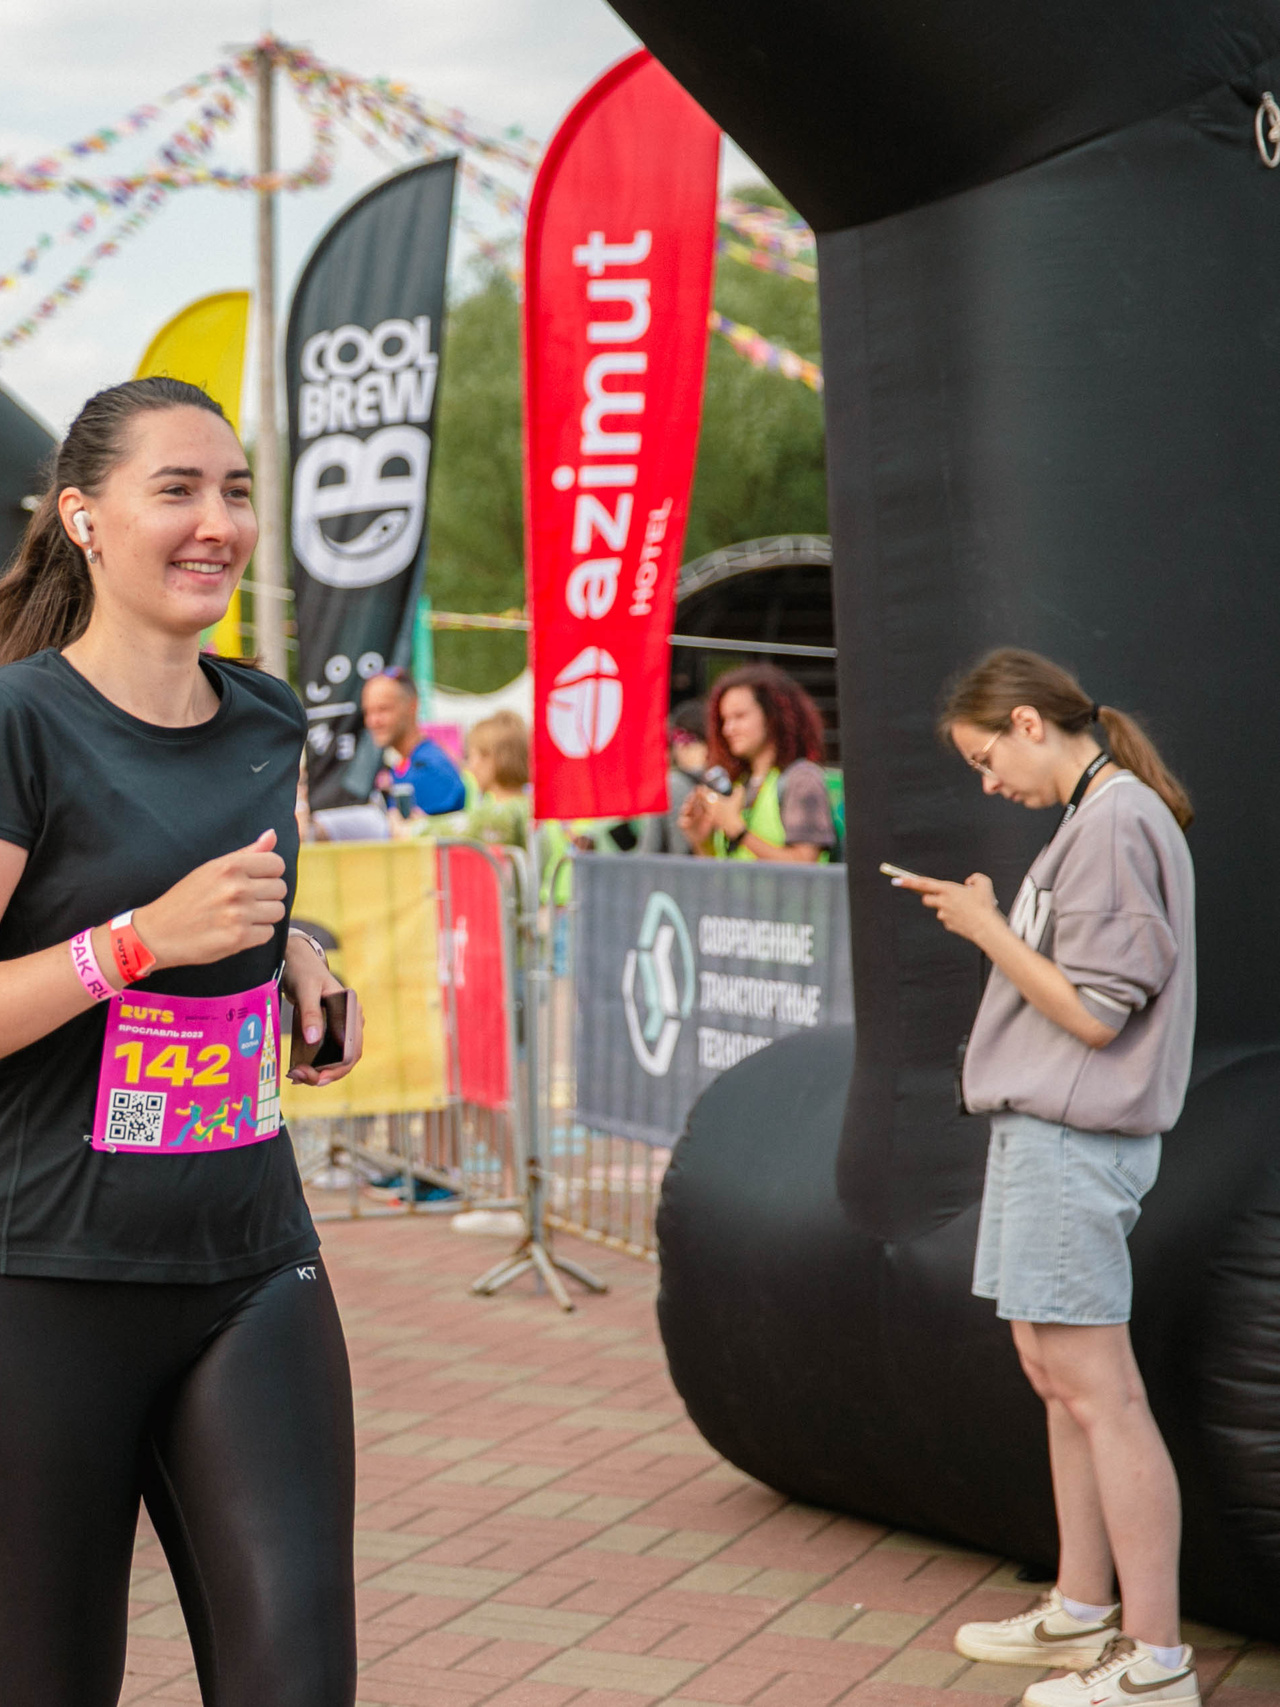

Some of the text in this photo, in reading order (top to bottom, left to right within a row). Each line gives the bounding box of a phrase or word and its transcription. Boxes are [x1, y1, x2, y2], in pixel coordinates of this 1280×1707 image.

[300, 314, 439, 383] COOL
[298, 366, 438, 440] BREW
[551, 229, 652, 620] azimut
[628, 496, 673, 617] HOTEL
[118, 1024, 204, 1039] ЯРОСЛАВЛЬ 2023
[120, 1004, 175, 1024] RUTS
[247, 1021, 256, 1040] 1
[114, 1041, 231, 1087] 142
[296, 1266, 317, 1280] KT
